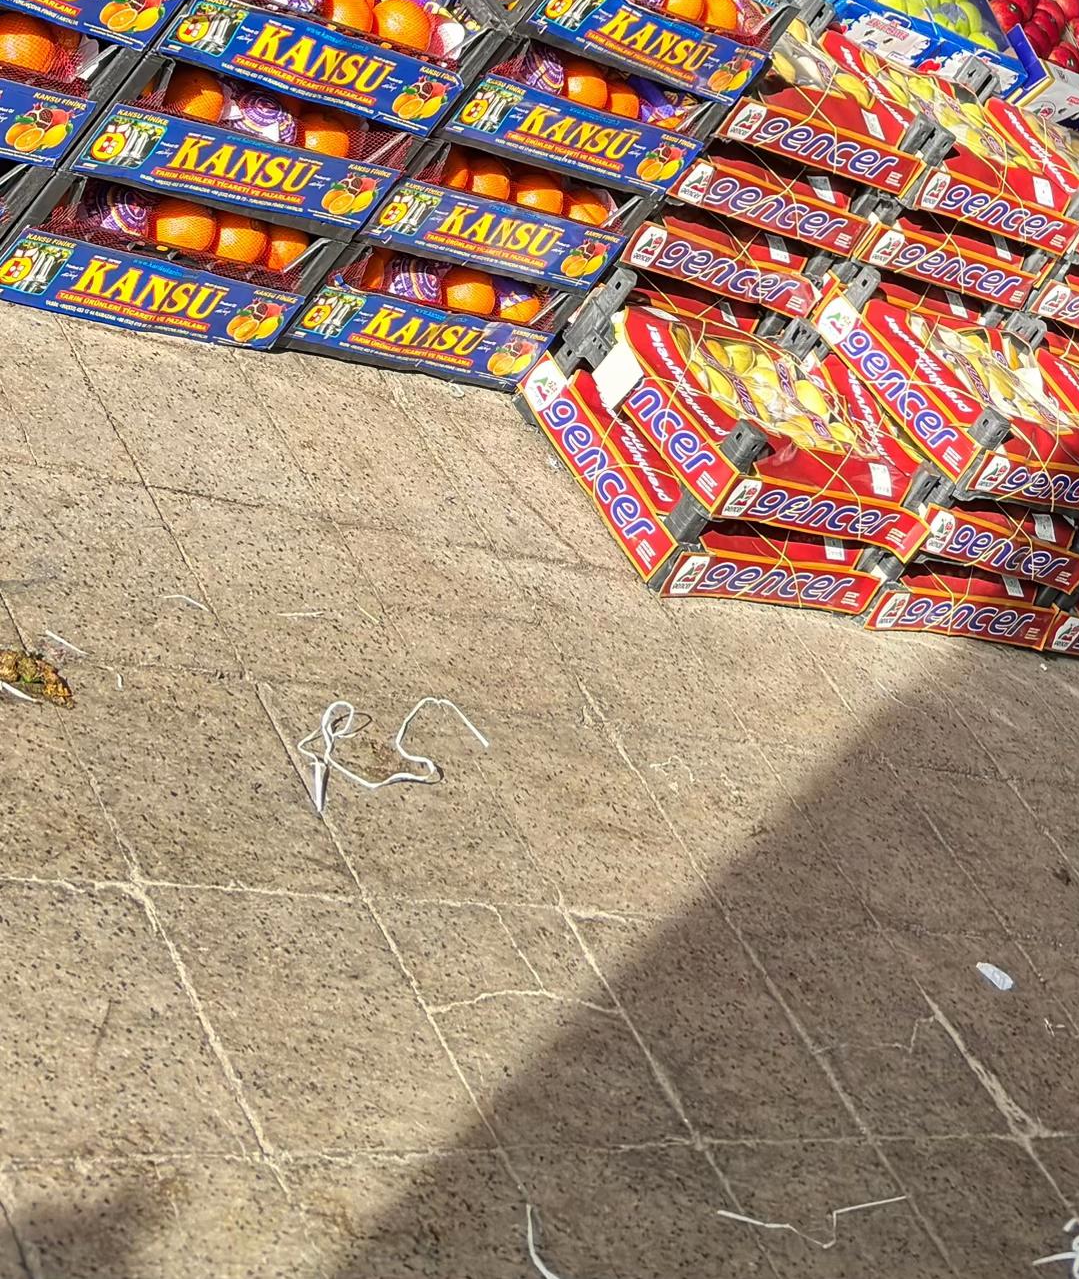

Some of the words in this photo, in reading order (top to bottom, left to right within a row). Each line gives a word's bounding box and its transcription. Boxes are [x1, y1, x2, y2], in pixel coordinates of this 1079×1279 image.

[246, 22, 394, 93] KANSU
[598, 8, 715, 72] KANSU
[33, 91, 61, 104] KANSU
[515, 105, 640, 160] KANSU
[752, 115, 899, 180] gencer
[166, 135, 321, 193] KANSU
[435, 205, 564, 256] KANSU
[705, 175, 850, 239] gencer
[941, 183, 1062, 241] gencer
[70, 258, 228, 321] KANSU
[658, 239, 799, 307] gencer
[898, 242, 1022, 298] gencer
[360, 307, 487, 356] KANSU
[678, 377, 731, 437] premium
[841, 328, 958, 447] gencer
[916, 355, 974, 413] premium
[628, 380, 716, 474] ncer
[543, 396, 657, 541] gencer
[622, 435, 674, 503] premium
[748, 488, 900, 536] gencer
[951, 523, 1070, 578] gencer
[698, 561, 854, 602] gencer
[903, 597, 1036, 638] gencer
